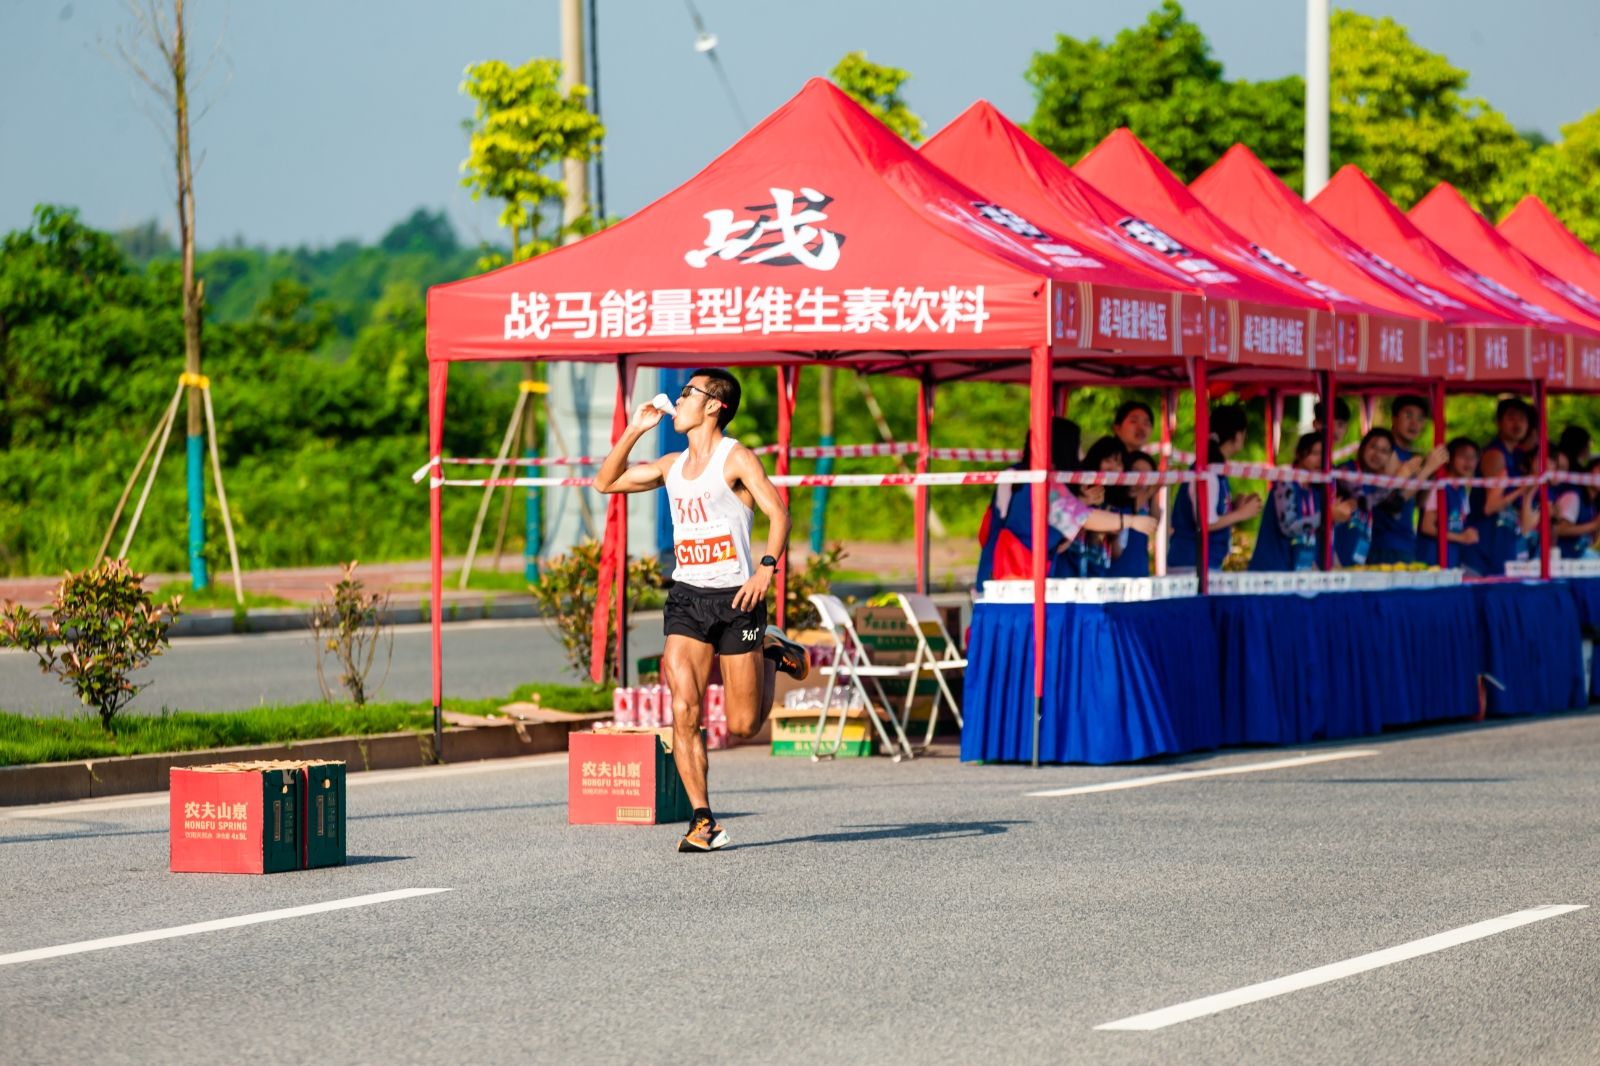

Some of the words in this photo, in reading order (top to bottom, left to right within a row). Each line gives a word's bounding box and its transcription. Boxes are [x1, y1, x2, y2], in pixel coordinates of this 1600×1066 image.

[503, 285, 989, 340] 战马能量型维生素饮料
[677, 541, 731, 564] C10747
[582, 761, 641, 778] 农夫山泉
[184, 801, 248, 820] 农夫山泉
[218, 821, 247, 831] SPRING
